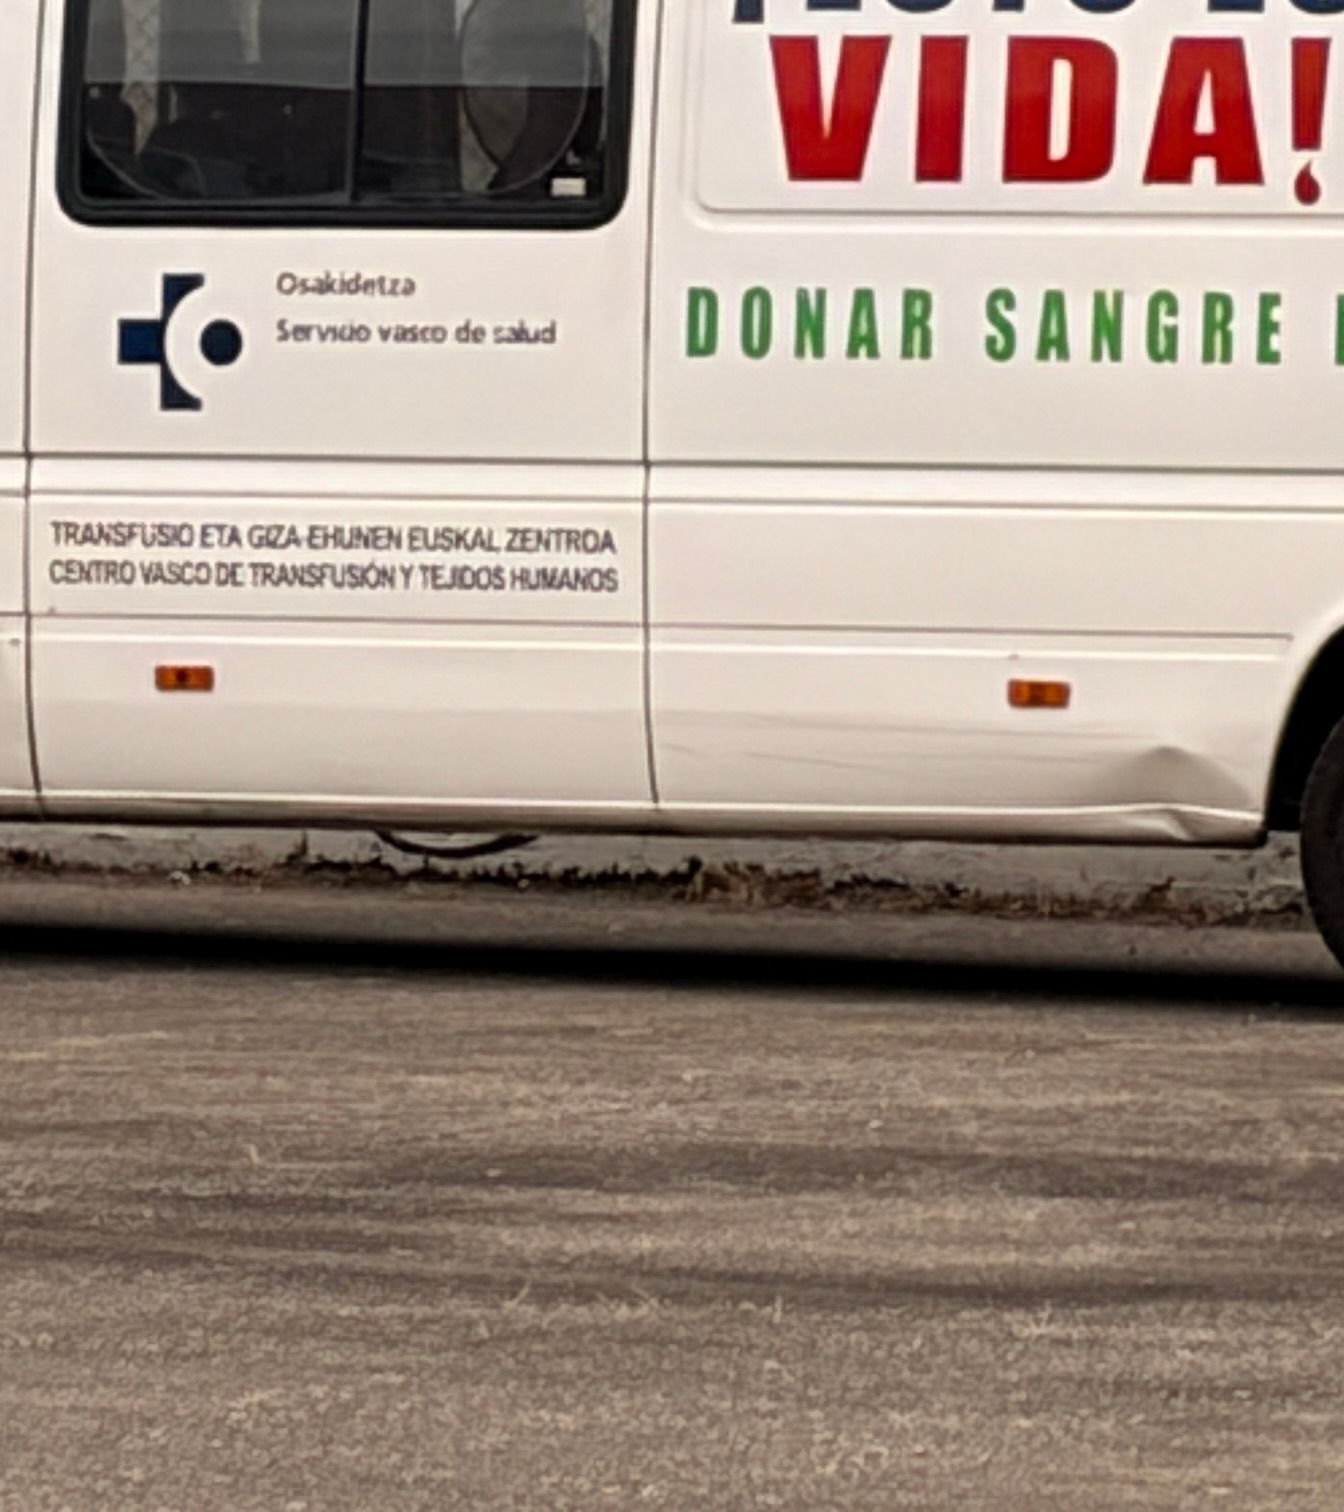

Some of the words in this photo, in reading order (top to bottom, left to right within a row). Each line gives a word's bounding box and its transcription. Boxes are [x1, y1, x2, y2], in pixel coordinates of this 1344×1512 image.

[769, 35, 1332, 206] VIDA!
[276, 271, 416, 296] Osakidetza
[276, 318, 371, 343] Servicio
[377, 324, 448, 344] vasco
[455, 319, 486, 344] de
[493, 319, 557, 344] salud
[685, 286, 932, 360] DONAR
[984, 288, 1281, 365] SANGRE
[49, 521, 194, 548] TRANSFUSIO
[199, 524, 243, 549] ETA
[407, 526, 502, 553] EUSKAL
[506, 527, 618, 555] ZENTROA
[49, 559, 136, 585] CENTRO
[139, 561, 212, 586] VASCO
[215, 562, 244, 587] DE
[248, 557, 397, 589] TRANSFUSIÓN
[398, 565, 414, 588] Y
[419, 564, 505, 590] TEJIDOS
[509, 566, 619, 592] HUMANOS
